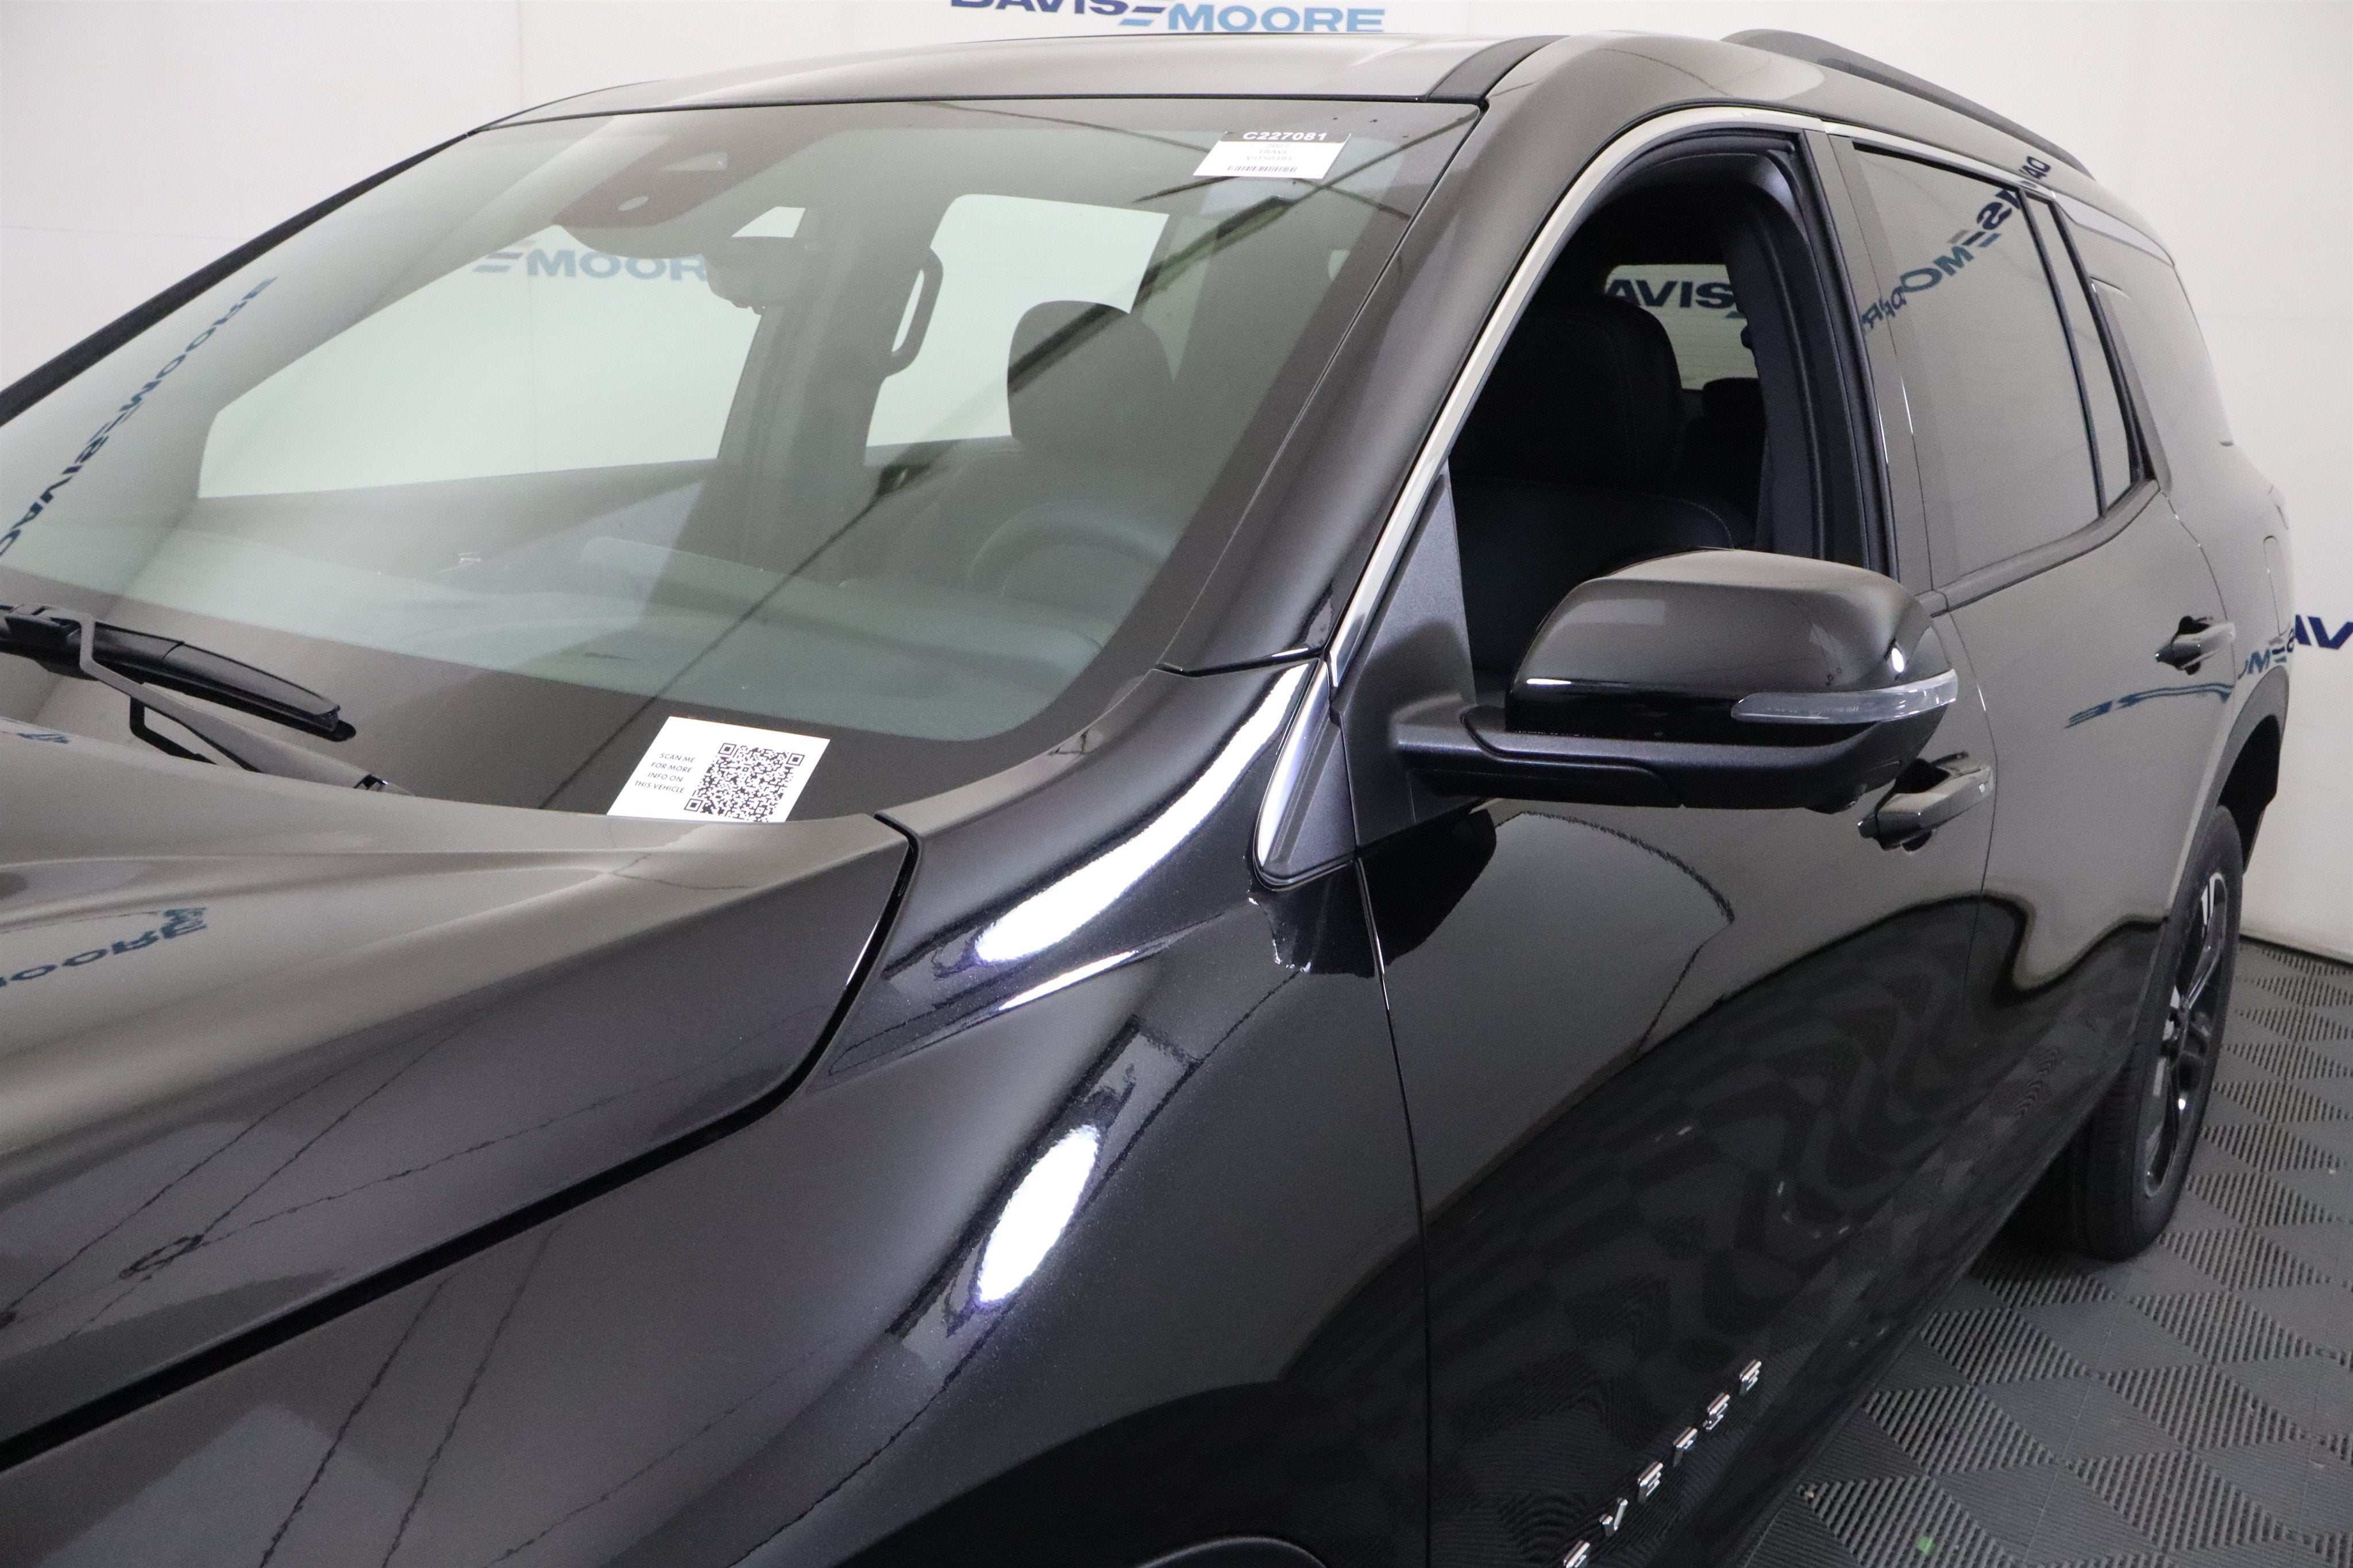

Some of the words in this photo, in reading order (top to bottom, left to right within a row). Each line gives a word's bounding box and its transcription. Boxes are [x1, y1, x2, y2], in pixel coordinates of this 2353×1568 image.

[951, 0, 1129, 16] VIS
[1168, 3, 1386, 32] MOORE
[1243, 132, 1327, 141] C227081
[659, 753, 682, 761] SCAN
[668, 764, 693, 773] MORE
[653, 783, 685, 793] VEHICLE
